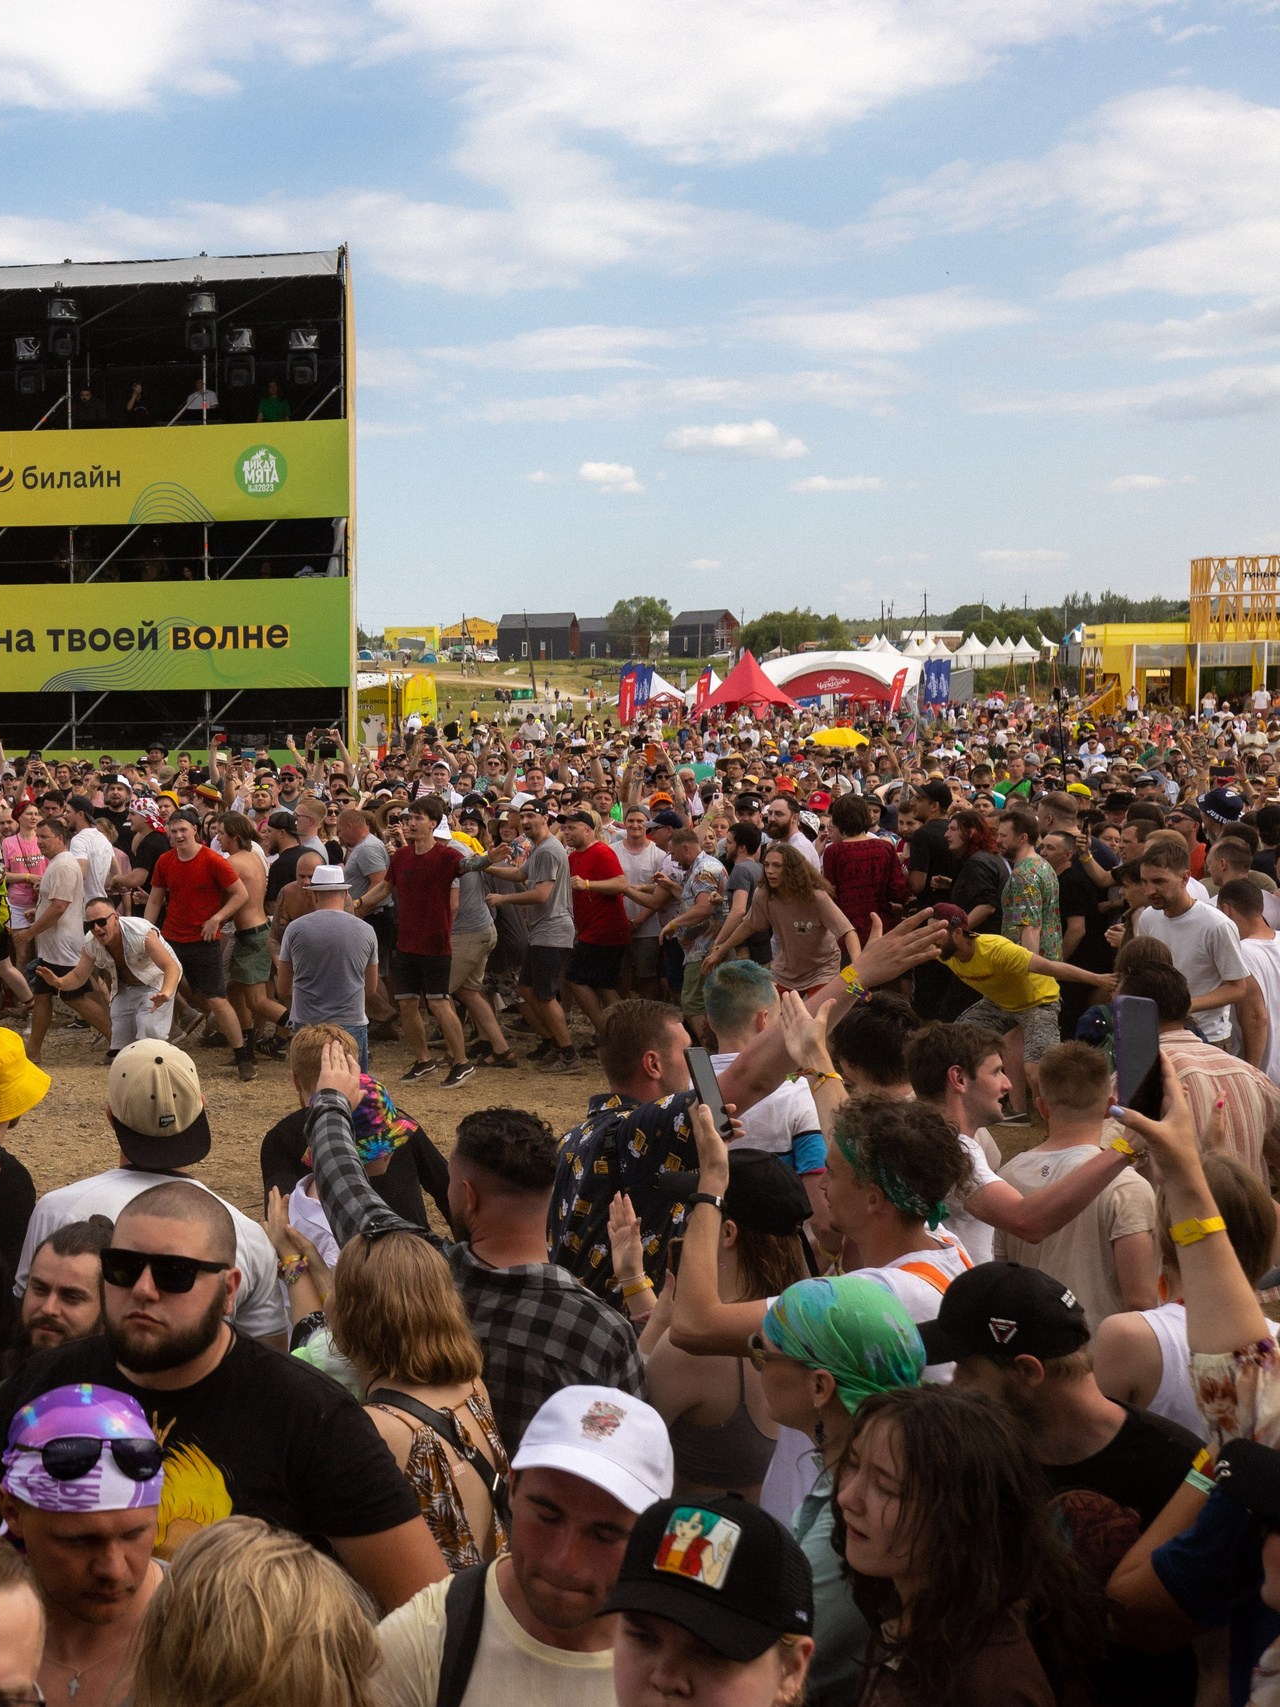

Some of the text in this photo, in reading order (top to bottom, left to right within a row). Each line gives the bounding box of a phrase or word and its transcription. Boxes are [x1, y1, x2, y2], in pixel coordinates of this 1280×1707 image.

[242, 460, 276, 471] ДИКАЯ
[22, 465, 121, 489] билайн
[244, 468, 280, 484] МЯТА
[258, 484, 274, 492] 2023
[46, 619, 159, 652] твоей
[172, 624, 290, 650] волне
[817, 677, 850, 690] Черкизово
